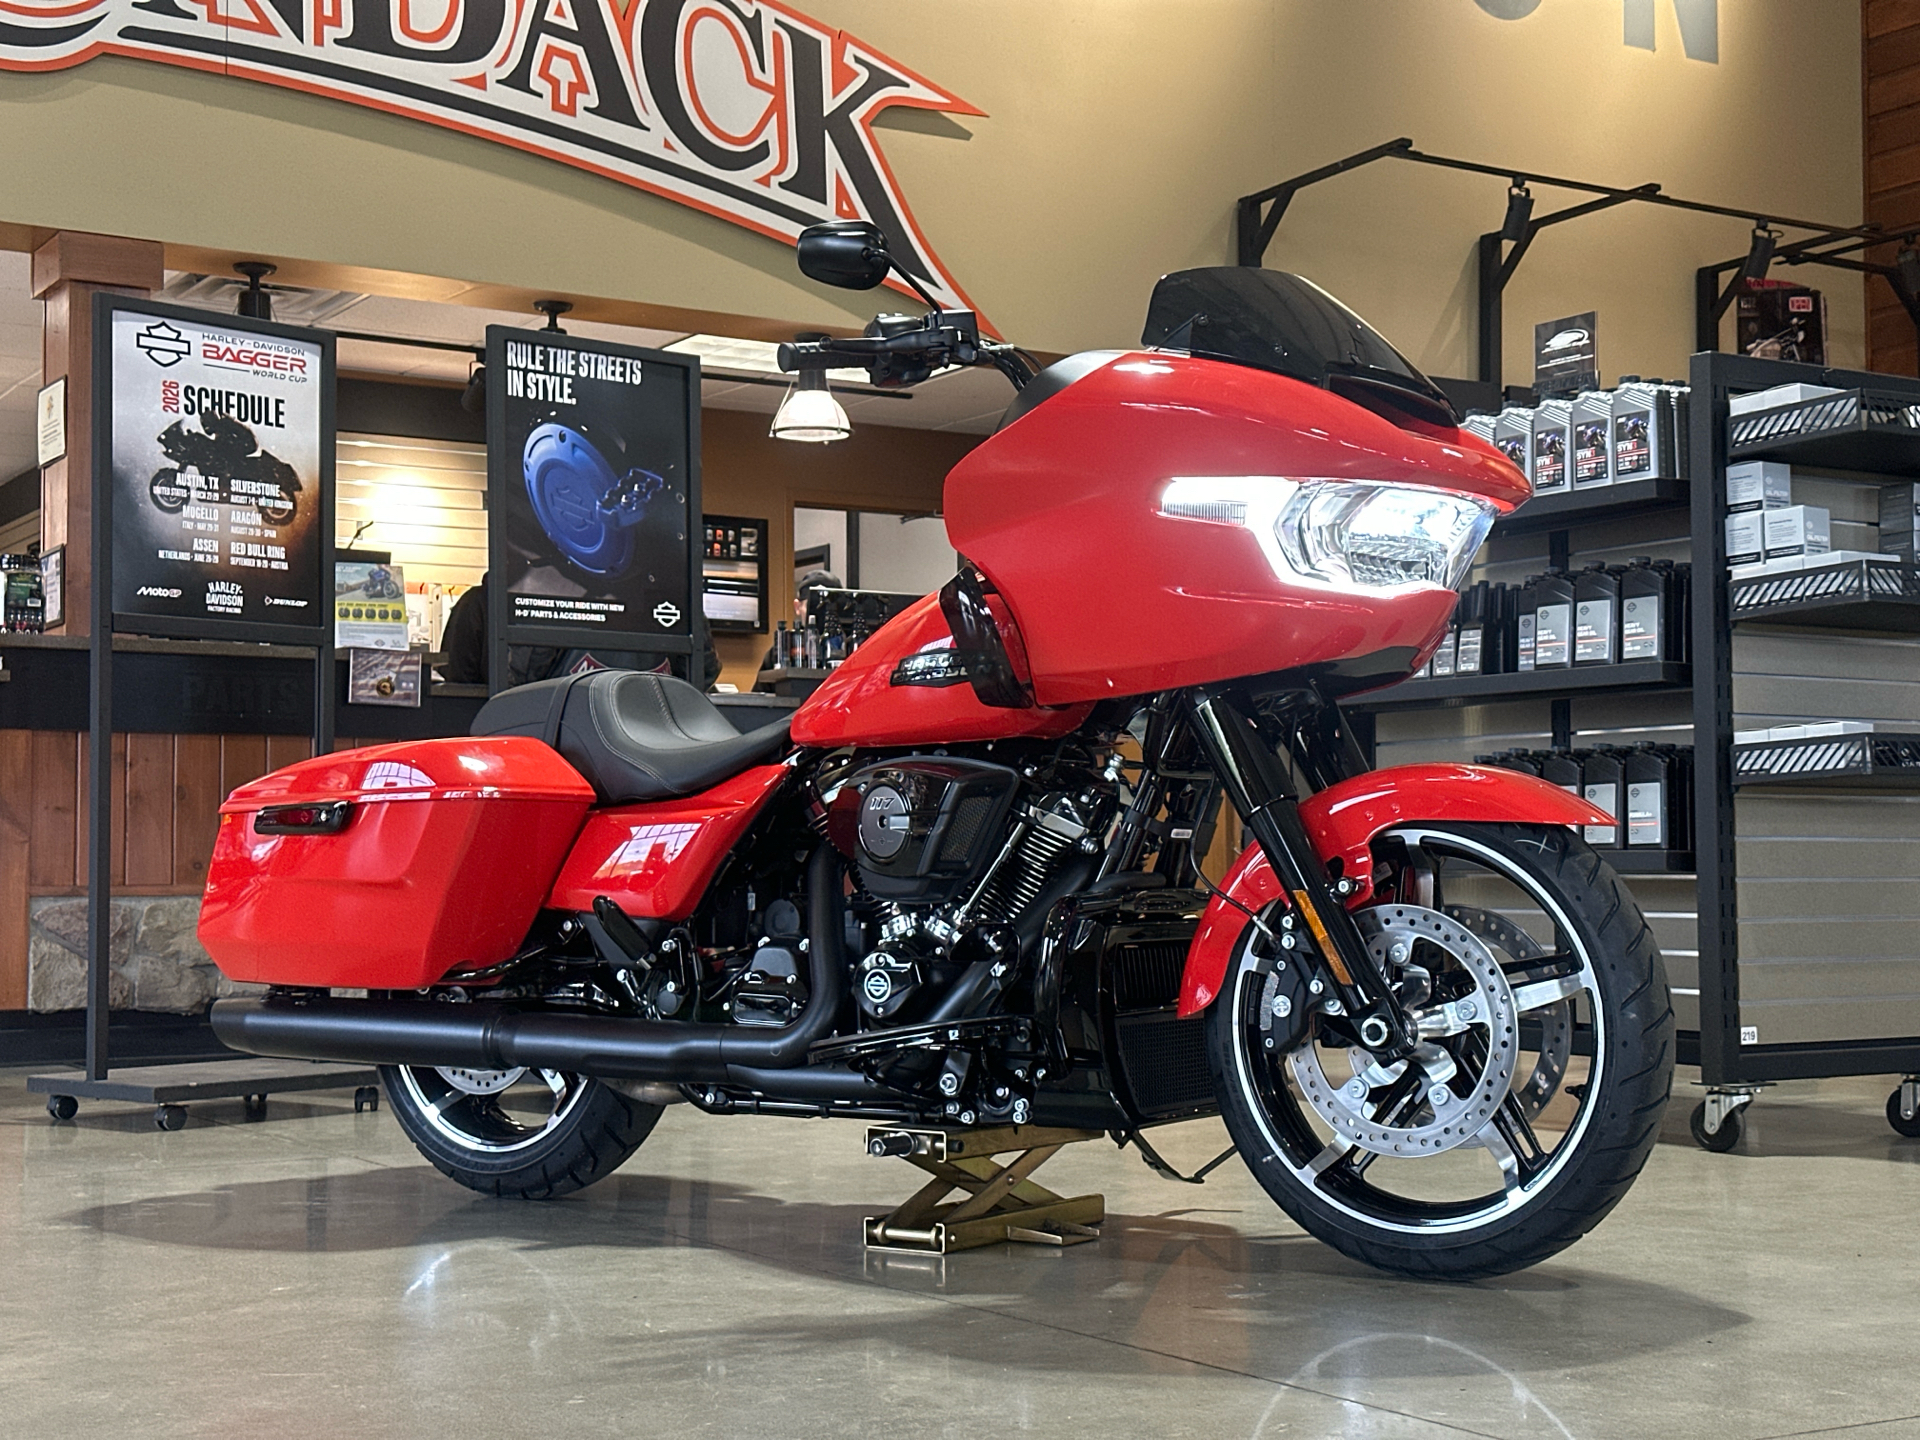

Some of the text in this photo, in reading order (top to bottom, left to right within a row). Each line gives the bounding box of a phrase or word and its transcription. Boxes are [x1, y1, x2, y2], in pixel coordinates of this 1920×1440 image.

[202, 343, 307, 374] BAGGER
[507, 341, 642, 385] RULE THE STREETS
[252, 369, 308, 384] WORLD CUP
[507, 369, 577, 405] IN STYLE.
[162, 380, 180, 413] 2026
[183, 385, 285, 428] SCHEDULE
[175, 472, 219, 490] AUSTIN, TX
[230, 479, 280, 497] SILVERSTONE
[182, 505, 219, 521] MUGELLO
[193, 538, 219, 552] ASSEN
[230, 542, 286, 559] RED BULL RING
[136, 586, 182, 598] MotoGP
[206, 593, 244, 607] DAVIDSON
[272, 598, 308, 607] DUNLOP
[515, 597, 625, 612] CUSTOMIZE YOUR RIDE WITH NEW
[530, 610, 553, 618] PARTS
[559, 611, 606, 622] ACCESSORIES
[870, 796, 896, 811] 117
[1742, 1030, 1756, 1042] 219
